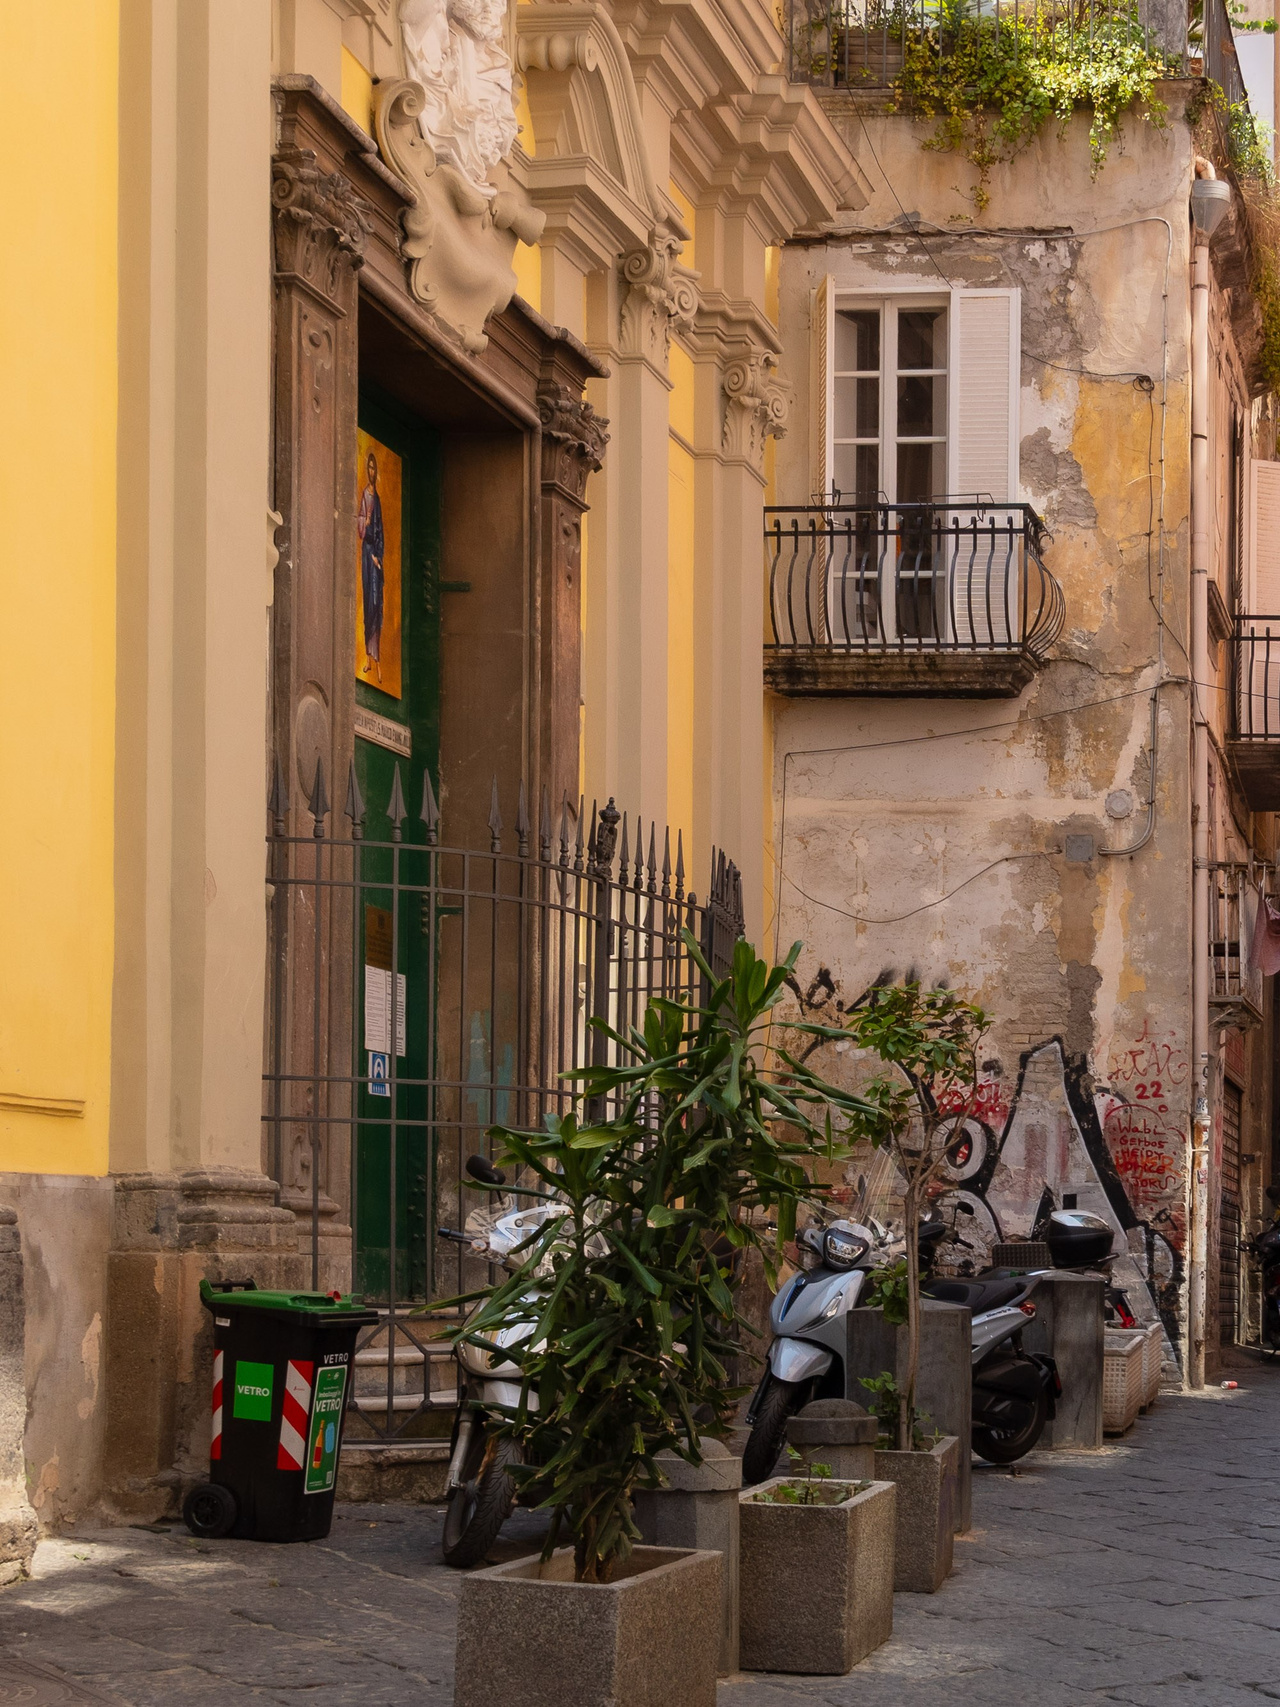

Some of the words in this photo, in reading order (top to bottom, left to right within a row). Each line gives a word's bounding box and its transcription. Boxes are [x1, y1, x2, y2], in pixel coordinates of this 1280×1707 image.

[1134, 1080, 1165, 1100] 22
[323, 1352, 349, 1364] VETRO
[237, 1384, 270, 1397] VETRO
[315, 1397, 341, 1412] VETRO
